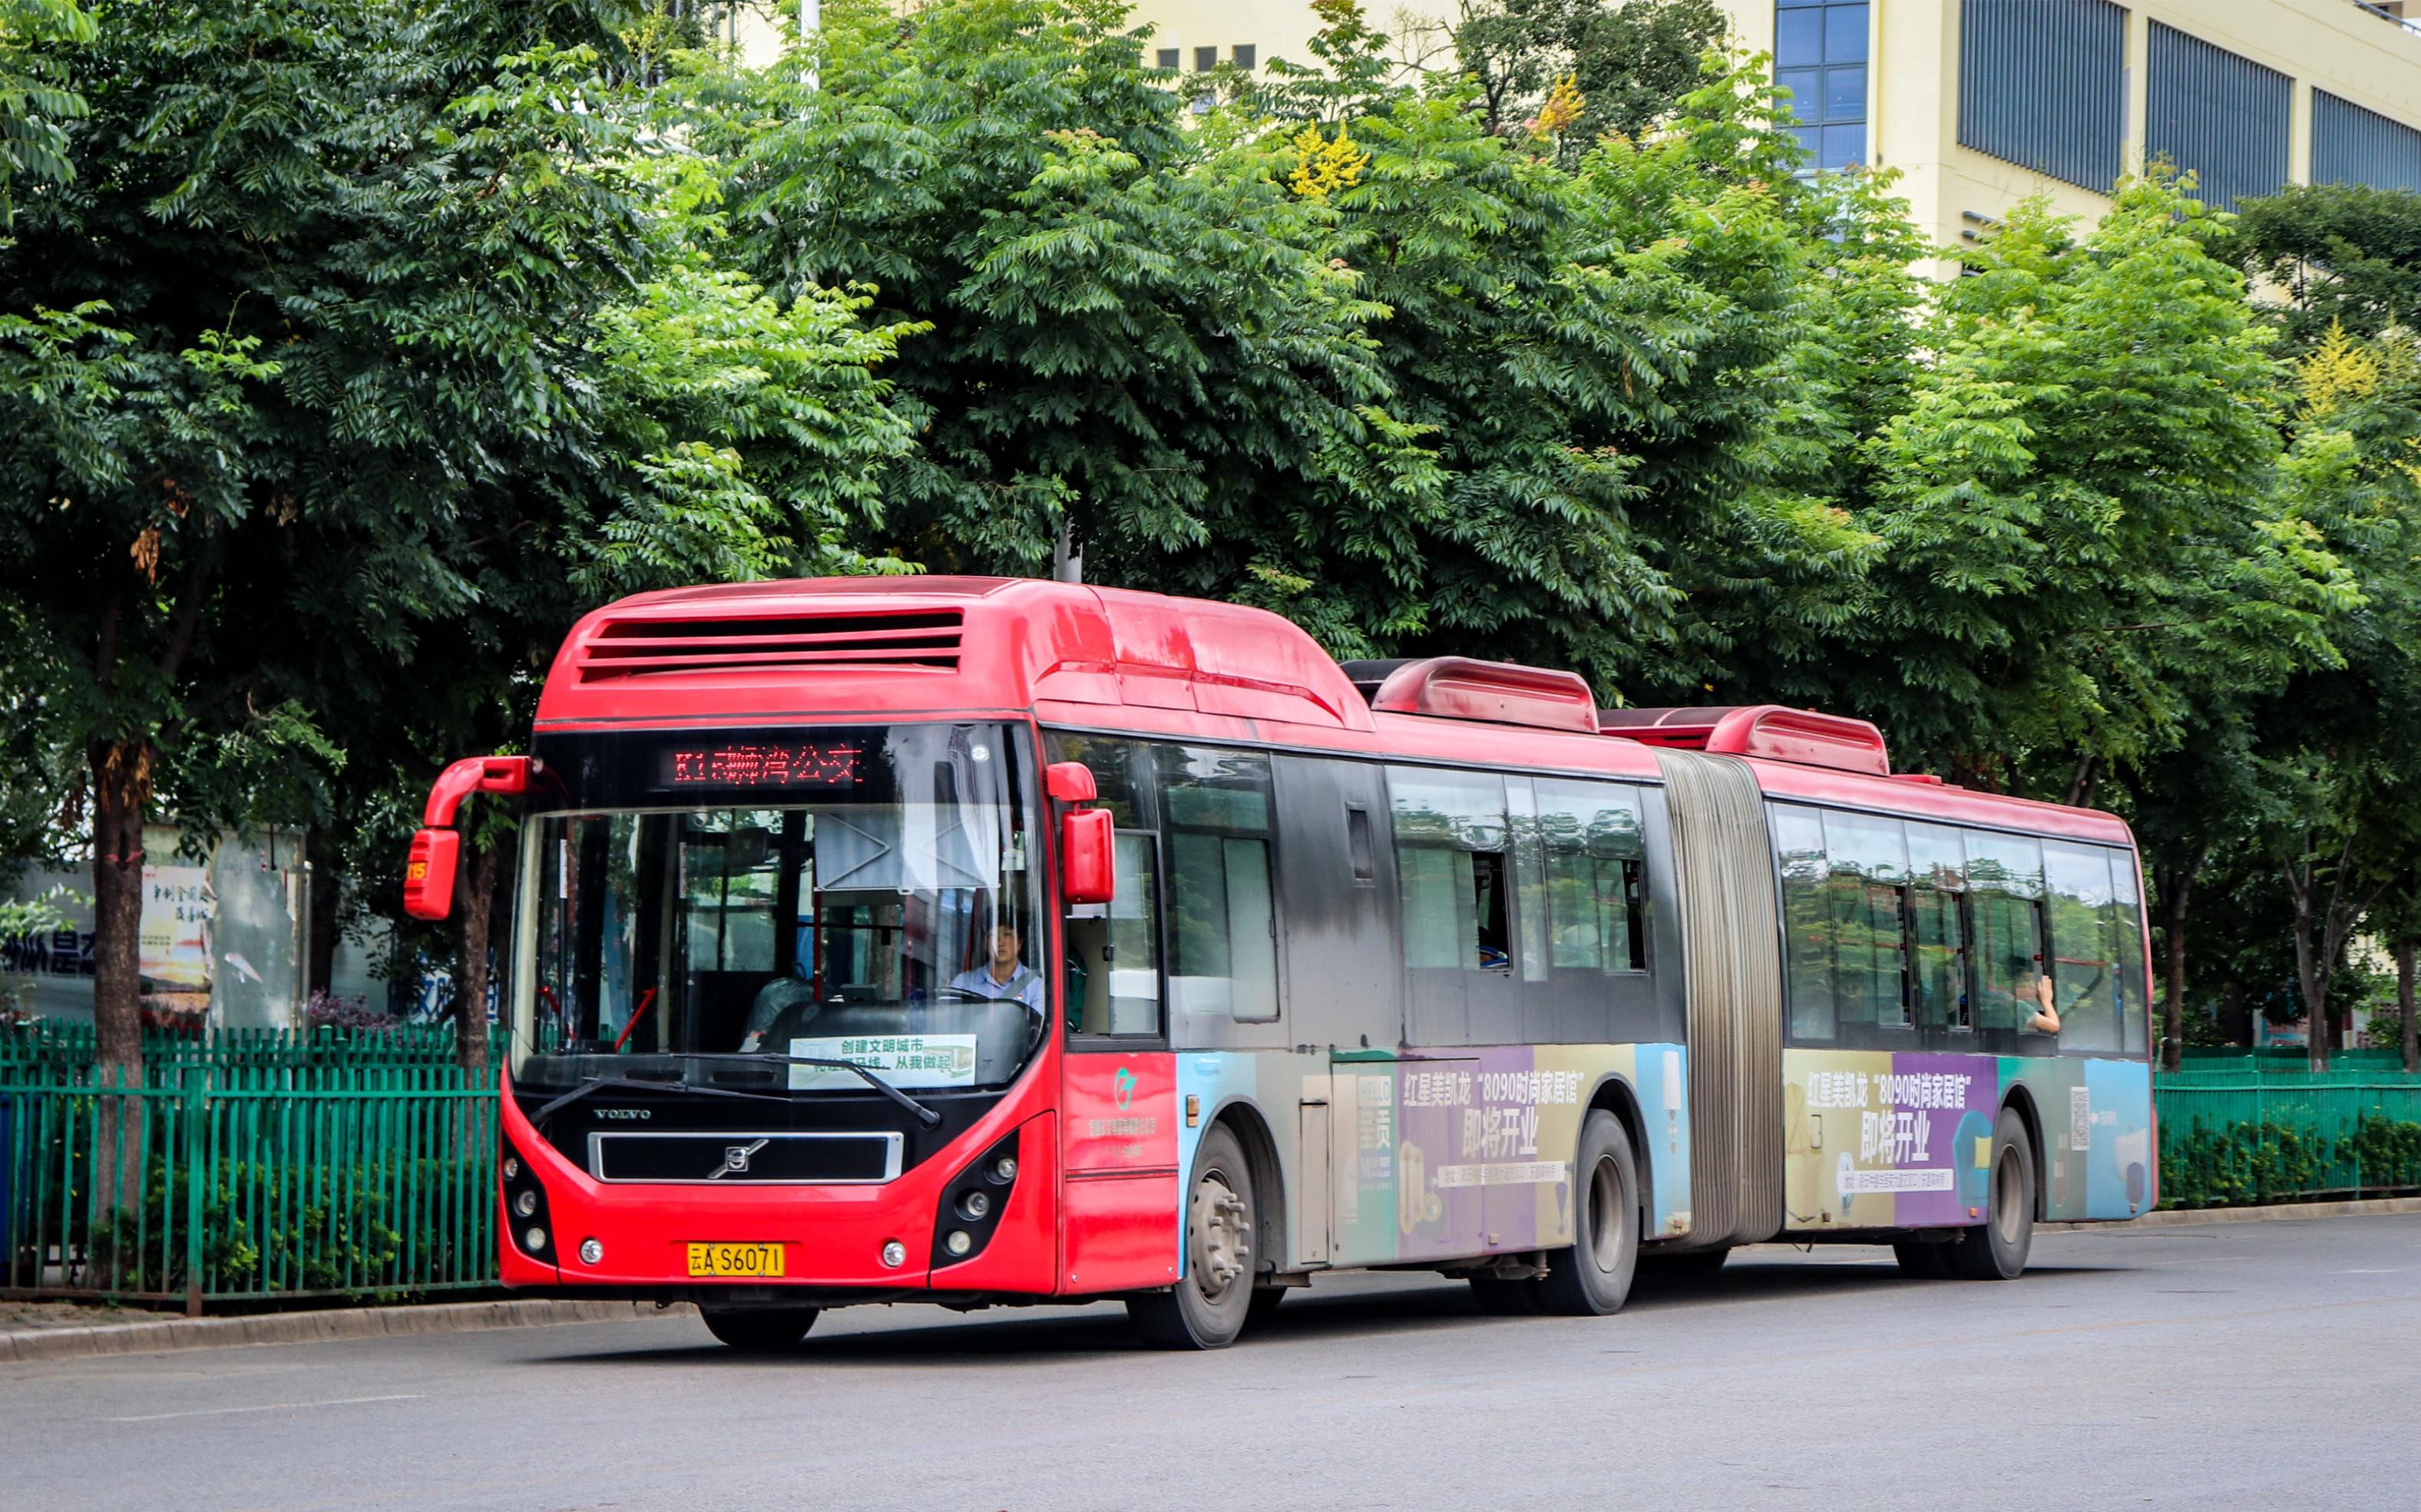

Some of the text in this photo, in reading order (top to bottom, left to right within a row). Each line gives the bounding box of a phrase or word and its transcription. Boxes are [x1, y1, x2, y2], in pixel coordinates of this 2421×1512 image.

[842, 1038, 923, 1054] 创建文明城市
[1403, 1071, 1471, 1107] 红星美凯龙
[1807, 1071, 1868, 1109] 红星美凯龙
[594, 1109, 651, 1119] VOLVO
[1463, 1106, 1539, 1158] 即将开业
[1860, 1110, 1930, 1164] 即将开业
